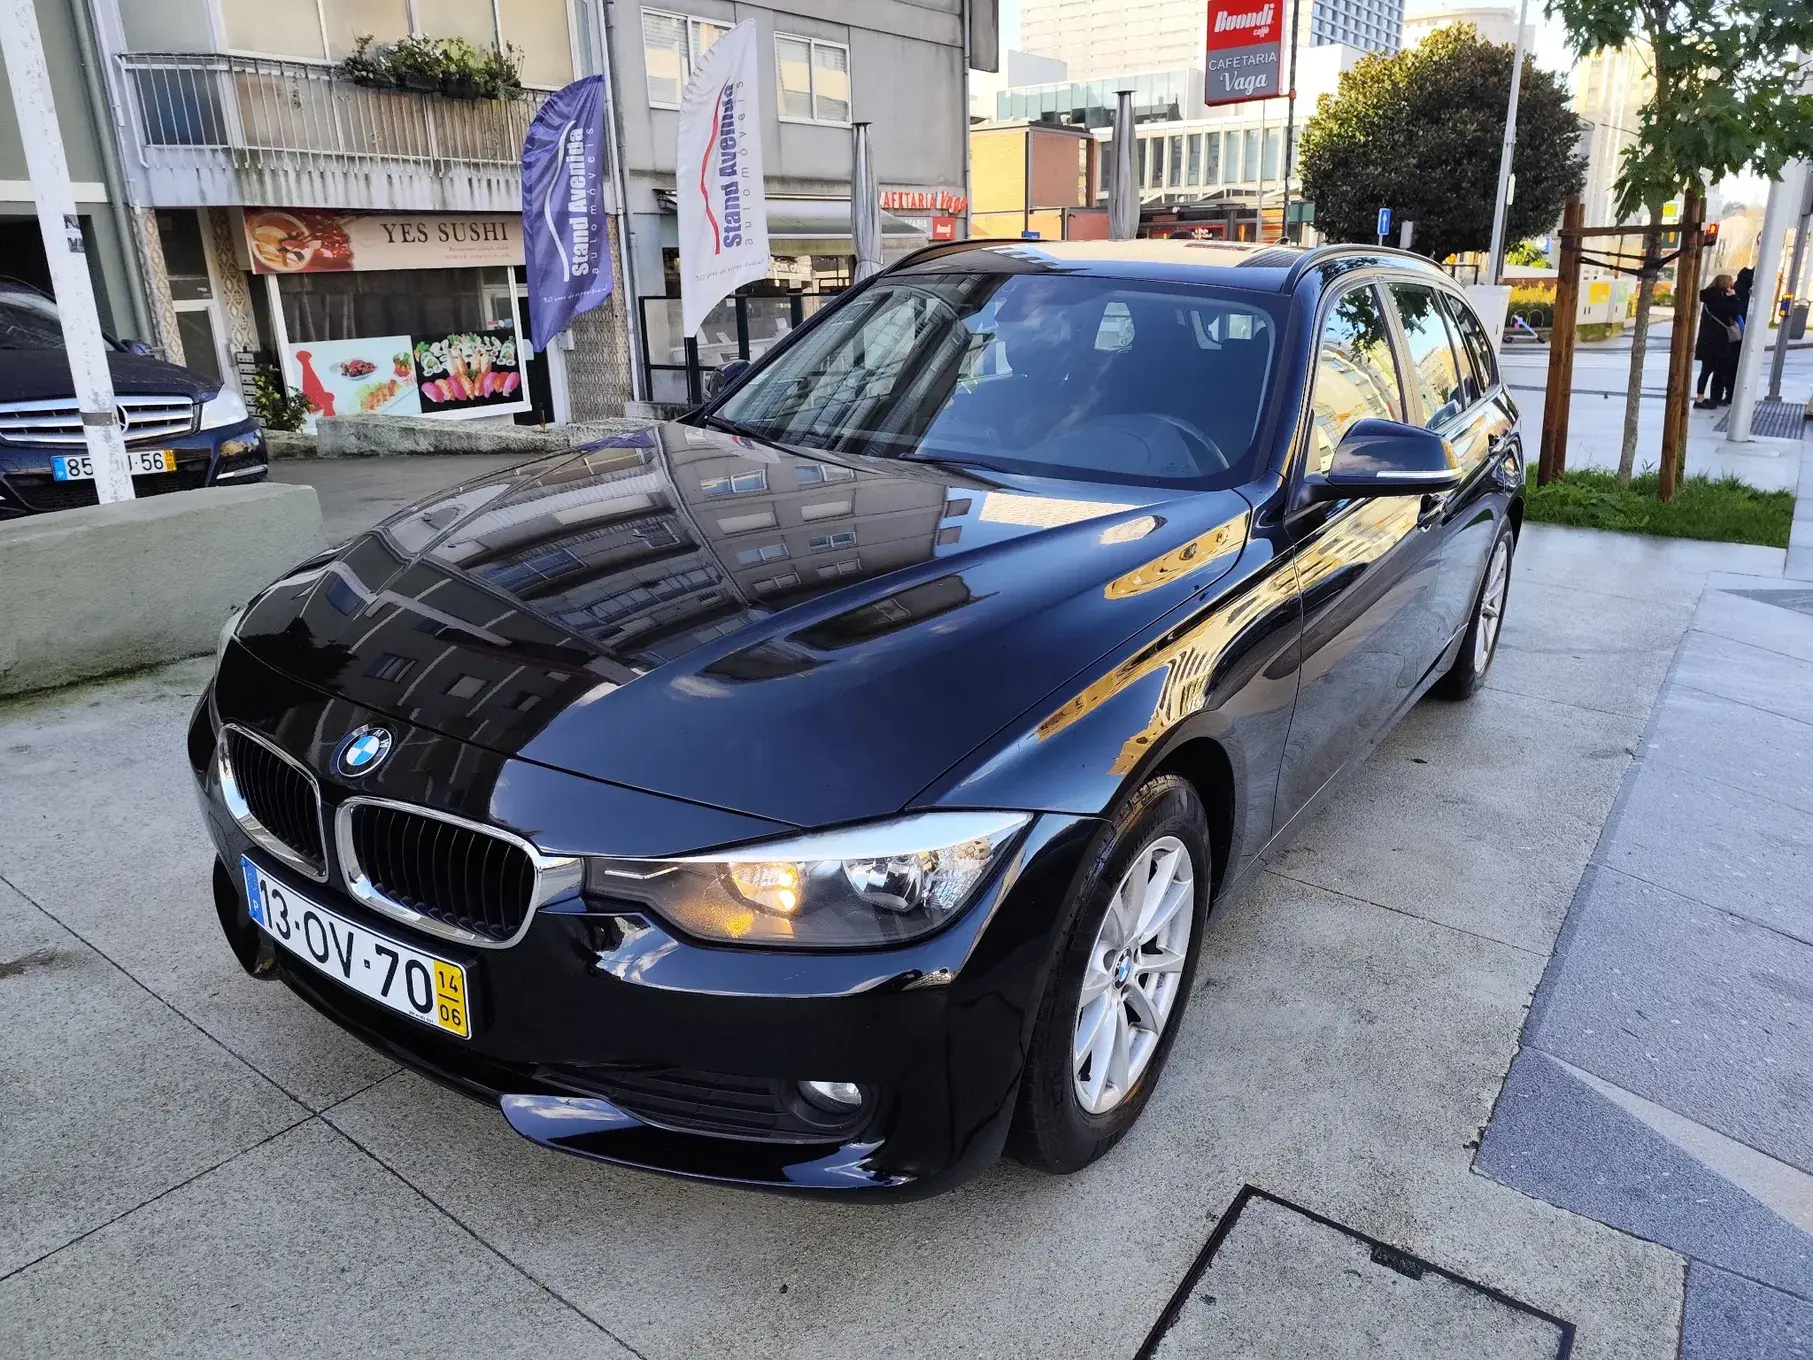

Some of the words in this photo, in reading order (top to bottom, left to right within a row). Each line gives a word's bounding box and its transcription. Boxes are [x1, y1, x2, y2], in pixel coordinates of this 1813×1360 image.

[1214, 3, 1275, 33] Buondi
[1209, 52, 1277, 71] CAFETARIA
[1220, 70, 1269, 96] Vaga
[566, 127, 588, 213] Avenida
[720, 181, 742, 248] Stand
[380, 223, 429, 244] YES
[438, 222, 510, 243] SUSHI
[569, 215, 590, 276] Stand
[438, 970, 459, 993] 14
[440, 1004, 462, 1027] 06
